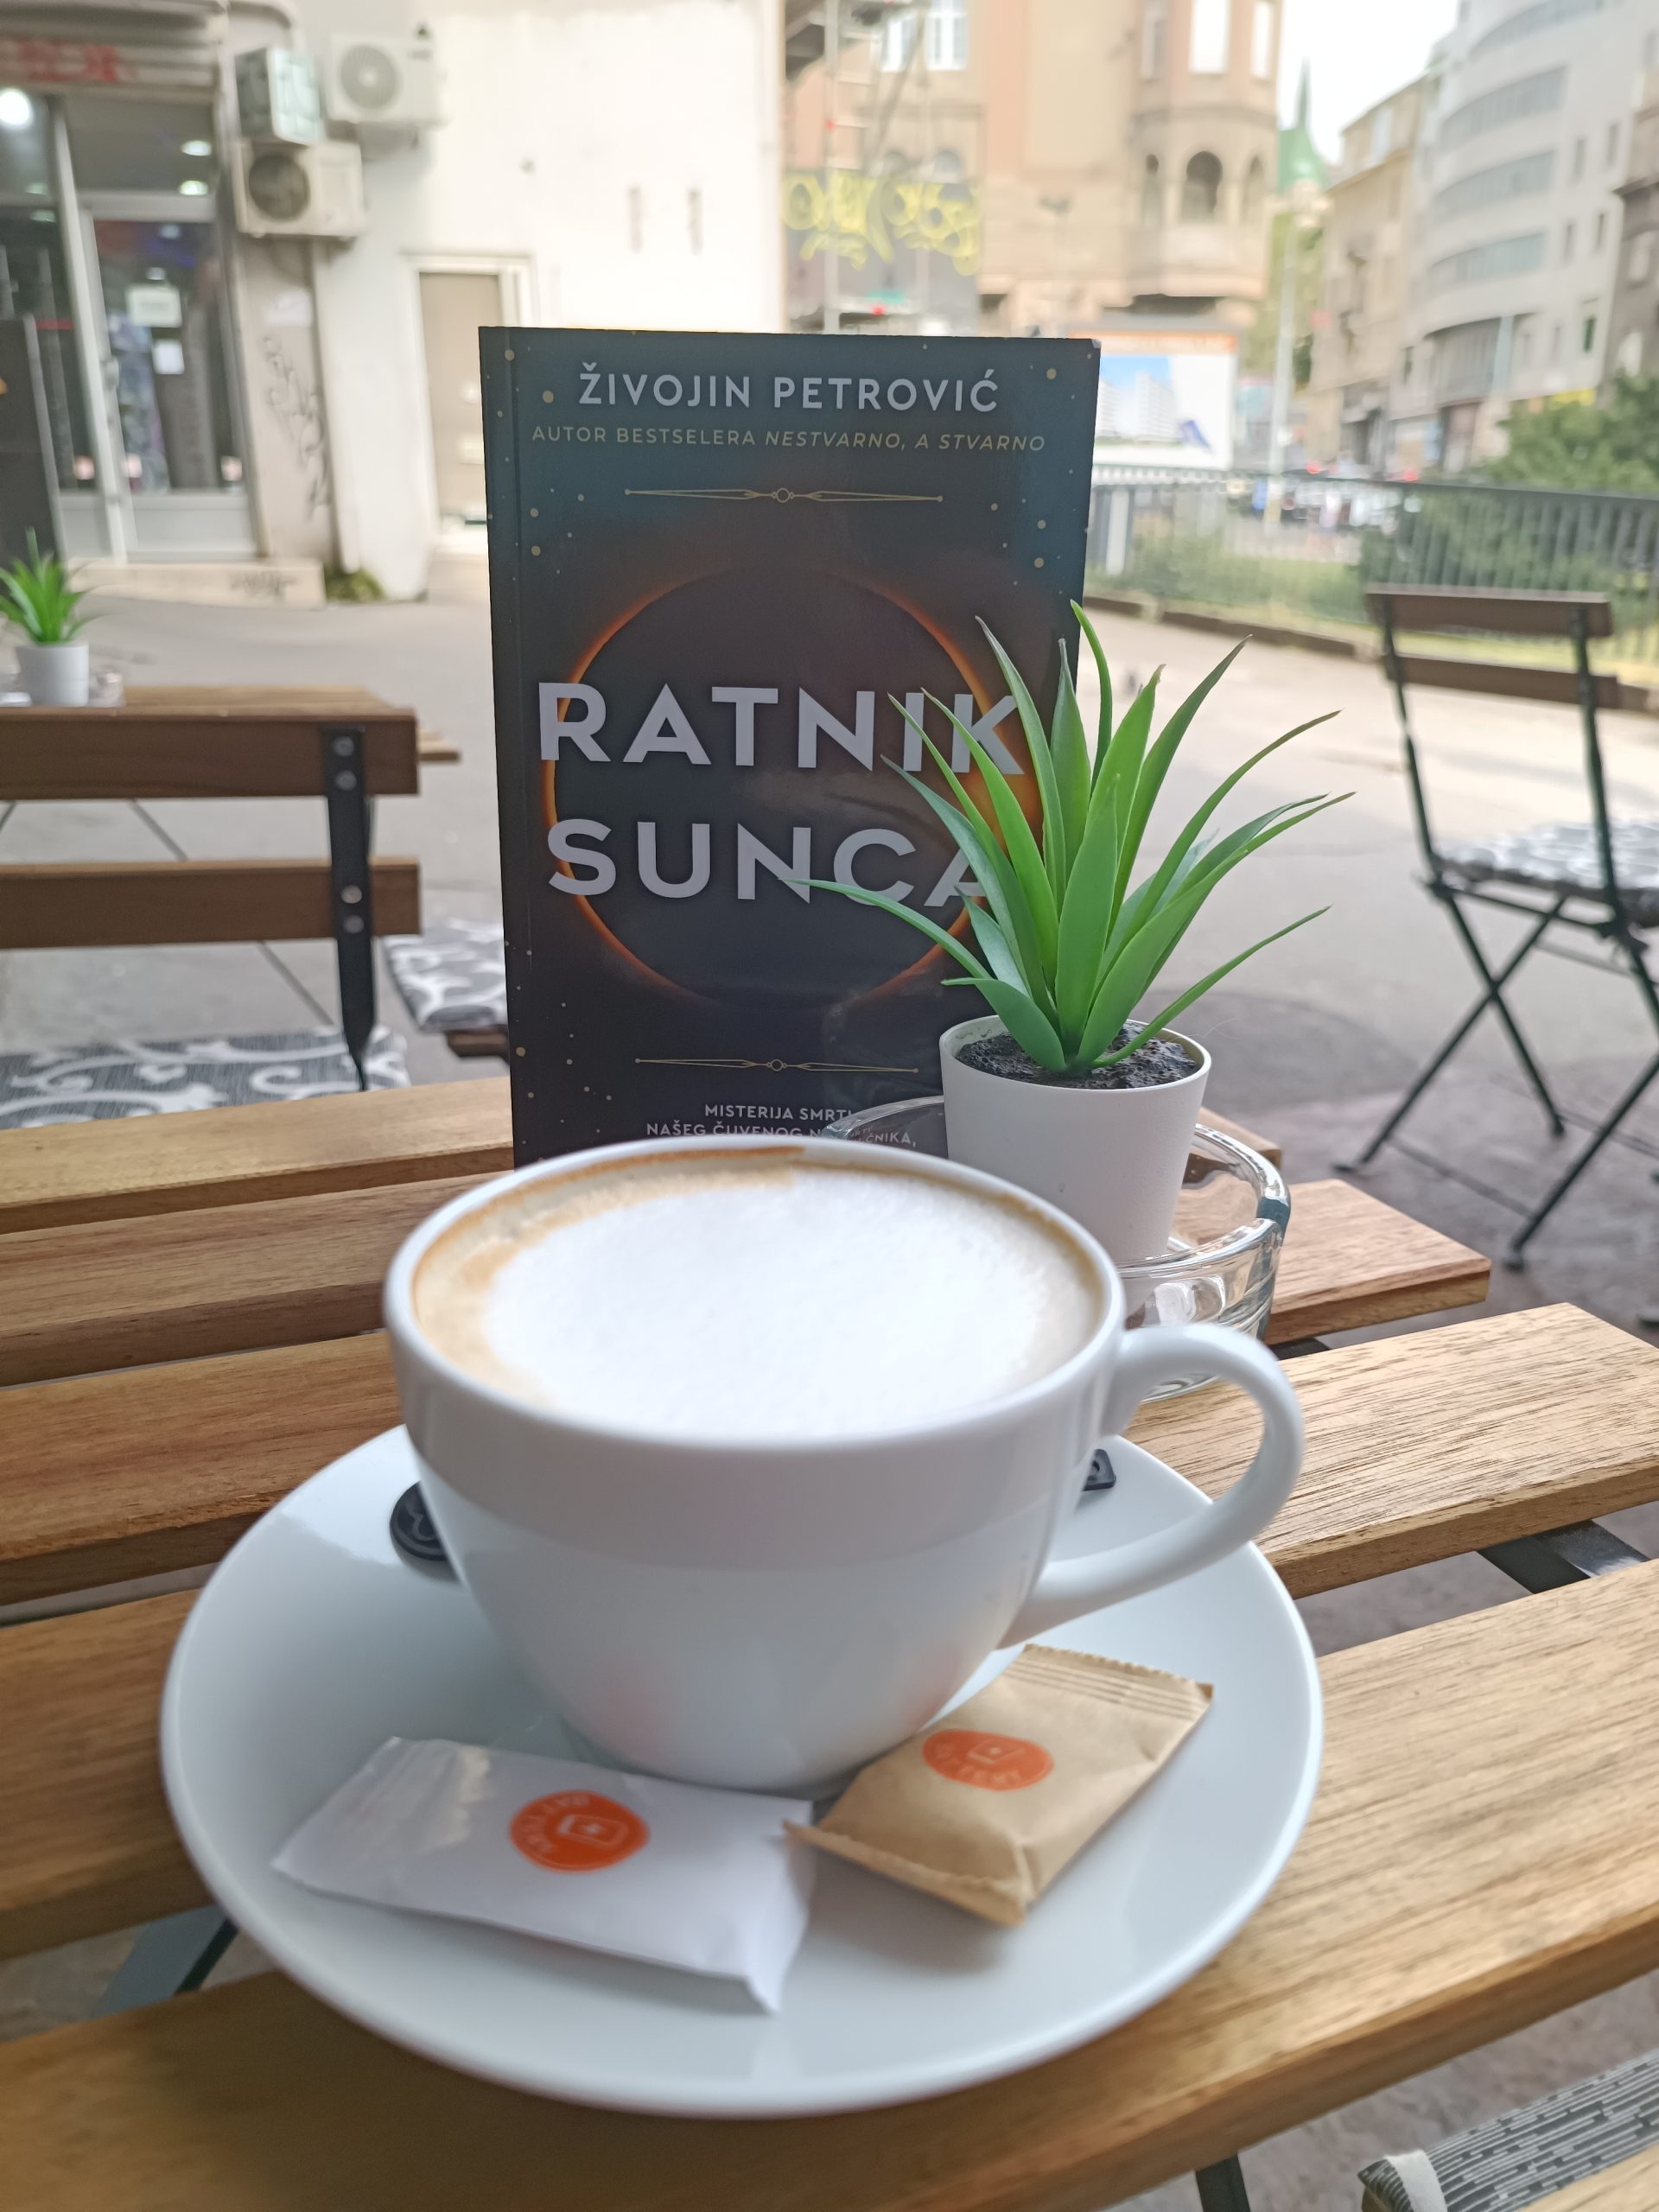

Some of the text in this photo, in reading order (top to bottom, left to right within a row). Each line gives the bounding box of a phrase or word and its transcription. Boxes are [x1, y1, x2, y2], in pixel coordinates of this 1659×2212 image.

[579, 362, 998, 412] ŽIVOJIN PETROVIĆ
[532, 426, 1046, 452] AUTOR BESTSELERA NESTVARNO, A STVARNO
[538, 683, 1025, 775] RATNIK
[704, 1103, 794, 1120] MISTERIJA
[646, 1120, 707, 1135] NAŠEG
